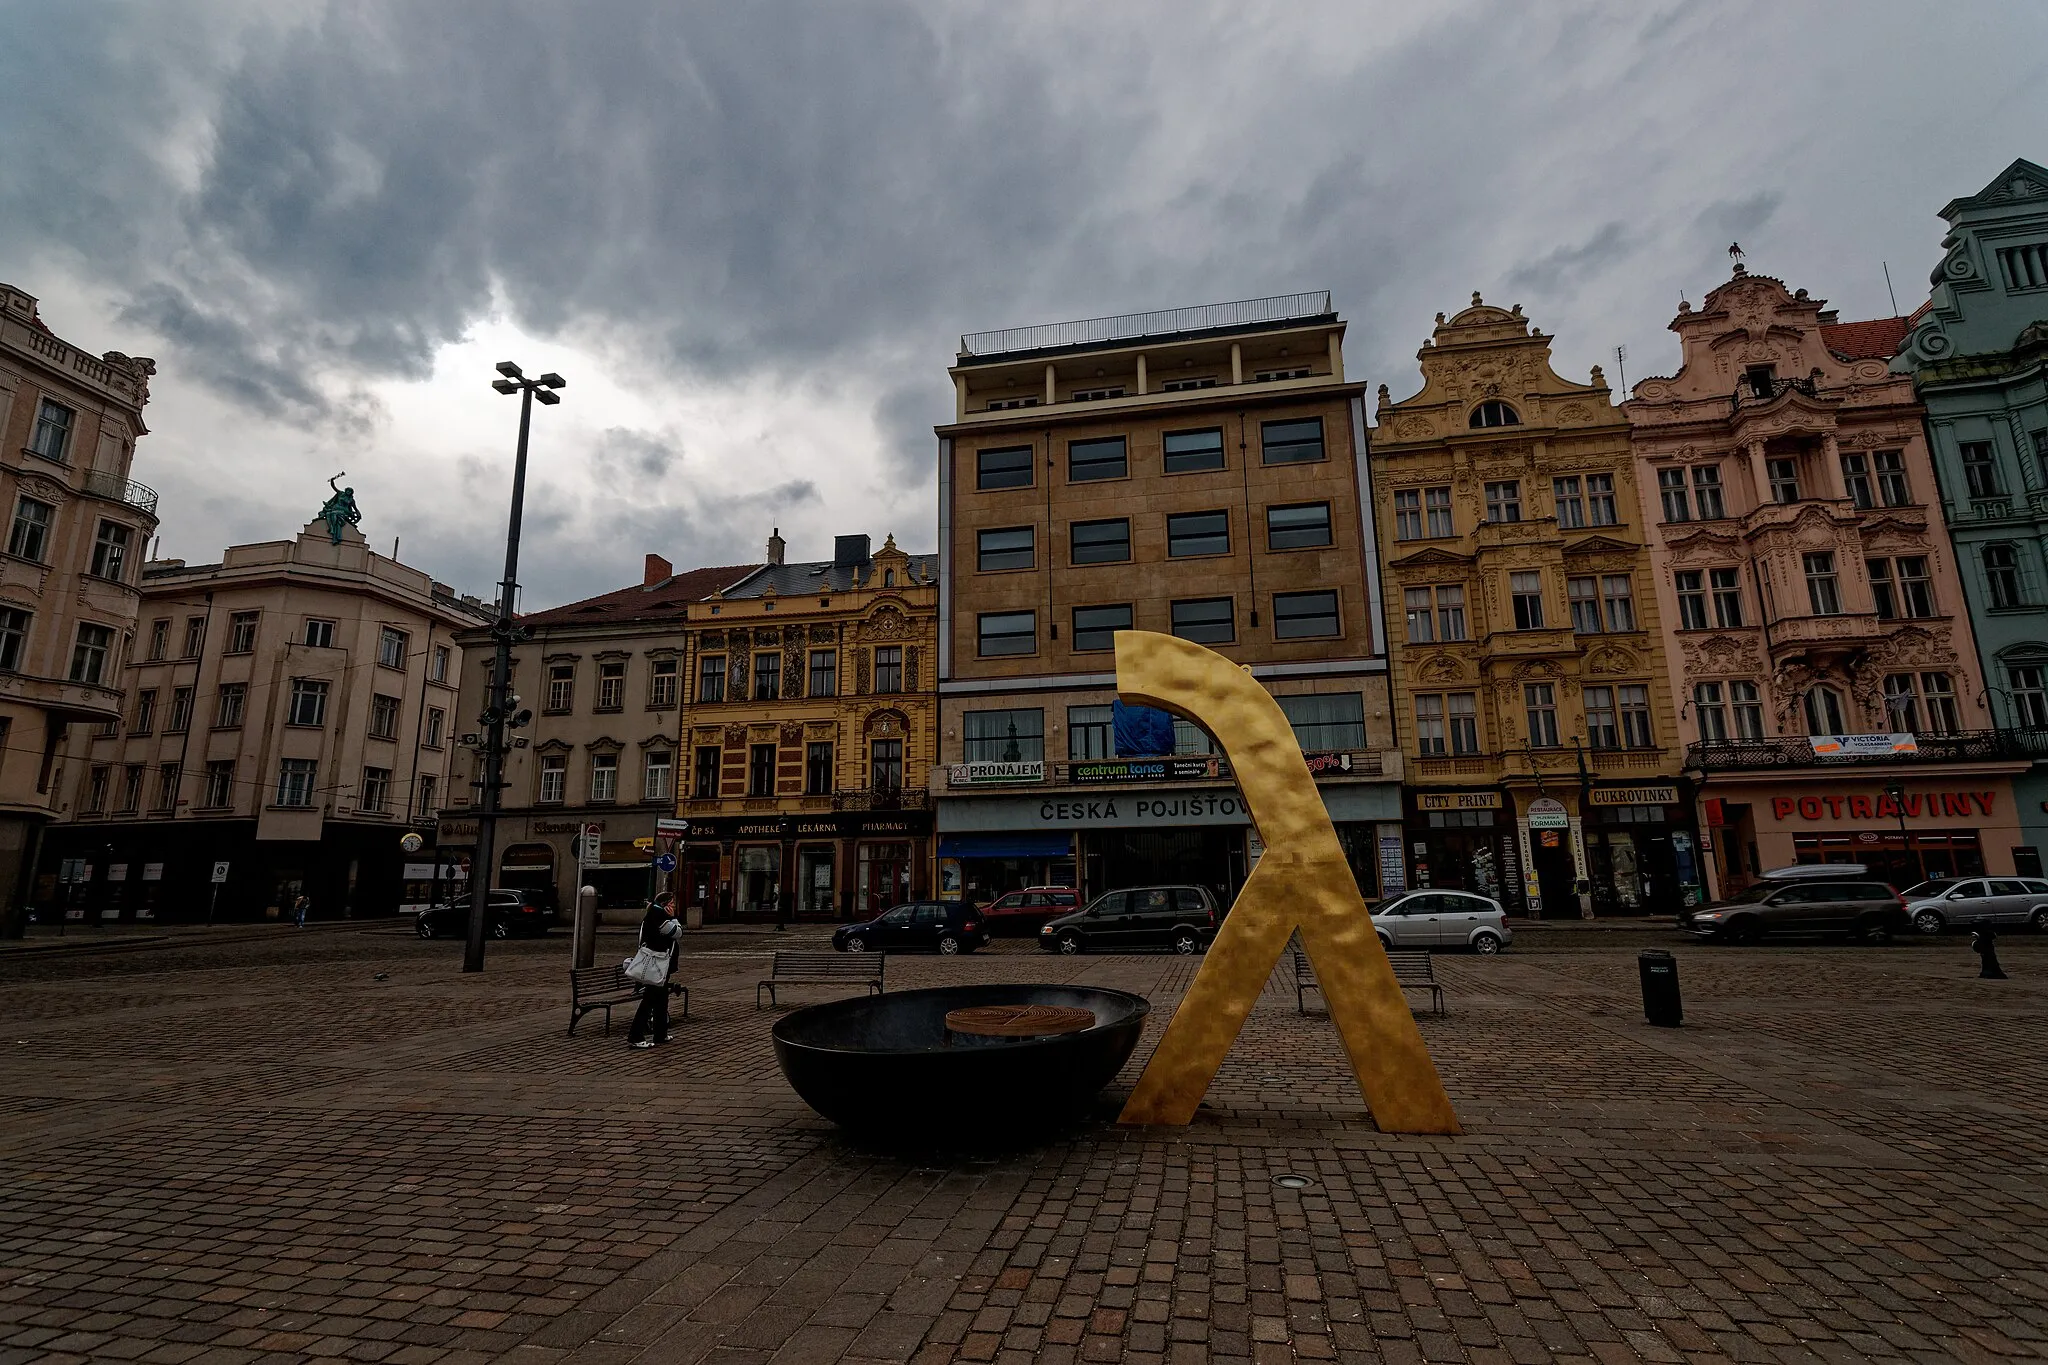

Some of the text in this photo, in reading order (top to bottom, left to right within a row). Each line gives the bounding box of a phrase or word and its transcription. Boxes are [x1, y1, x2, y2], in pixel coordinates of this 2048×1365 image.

[970, 763, 1041, 776] PRONÁJEM
[1077, 762, 1165, 776] centrum tance
[1424, 794, 1495, 808] CITY PRINT
[1593, 788, 1673, 803] CUKROVINKY
[1040, 799, 1118, 820] ČESKÁ
[1771, 791, 1997, 821] POTRAVINY
[738, 824, 781, 834] APOTHEKE
[797, 822, 836, 832] LÉKÁRNA
[862, 820, 909, 831] PHARMACY
